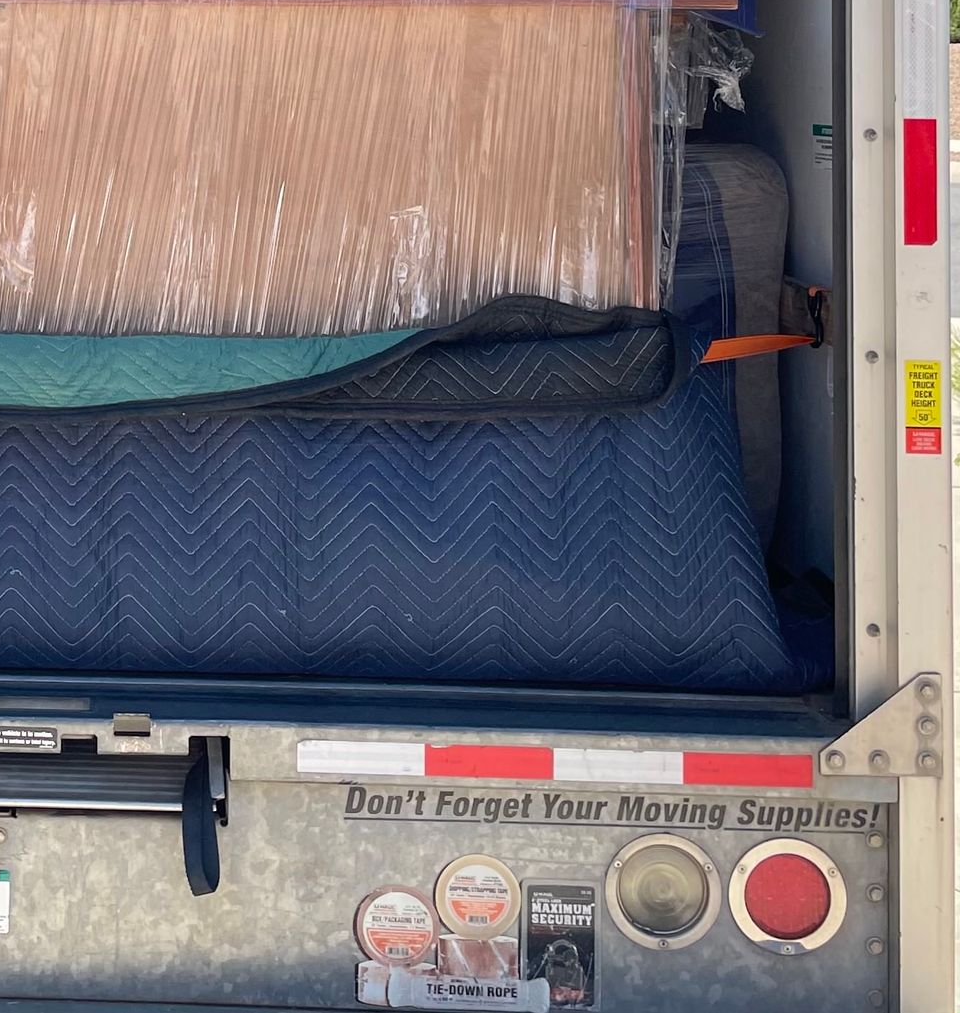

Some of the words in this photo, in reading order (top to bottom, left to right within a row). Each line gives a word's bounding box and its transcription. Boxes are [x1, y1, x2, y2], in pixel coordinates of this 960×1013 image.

[344, 786, 427, 816] Don't
[435, 790, 532, 824] Forget
[542, 794, 608, 820] Your
[616, 796, 727, 830] Moving
[737, 799, 881, 832] Supplies!
[531, 903, 592, 914] MAXIMUM
[531, 914, 592, 926] SECURITY
[426, 983, 484, 997] TIE-DOWN
[487, 987, 518, 998] ROPE
